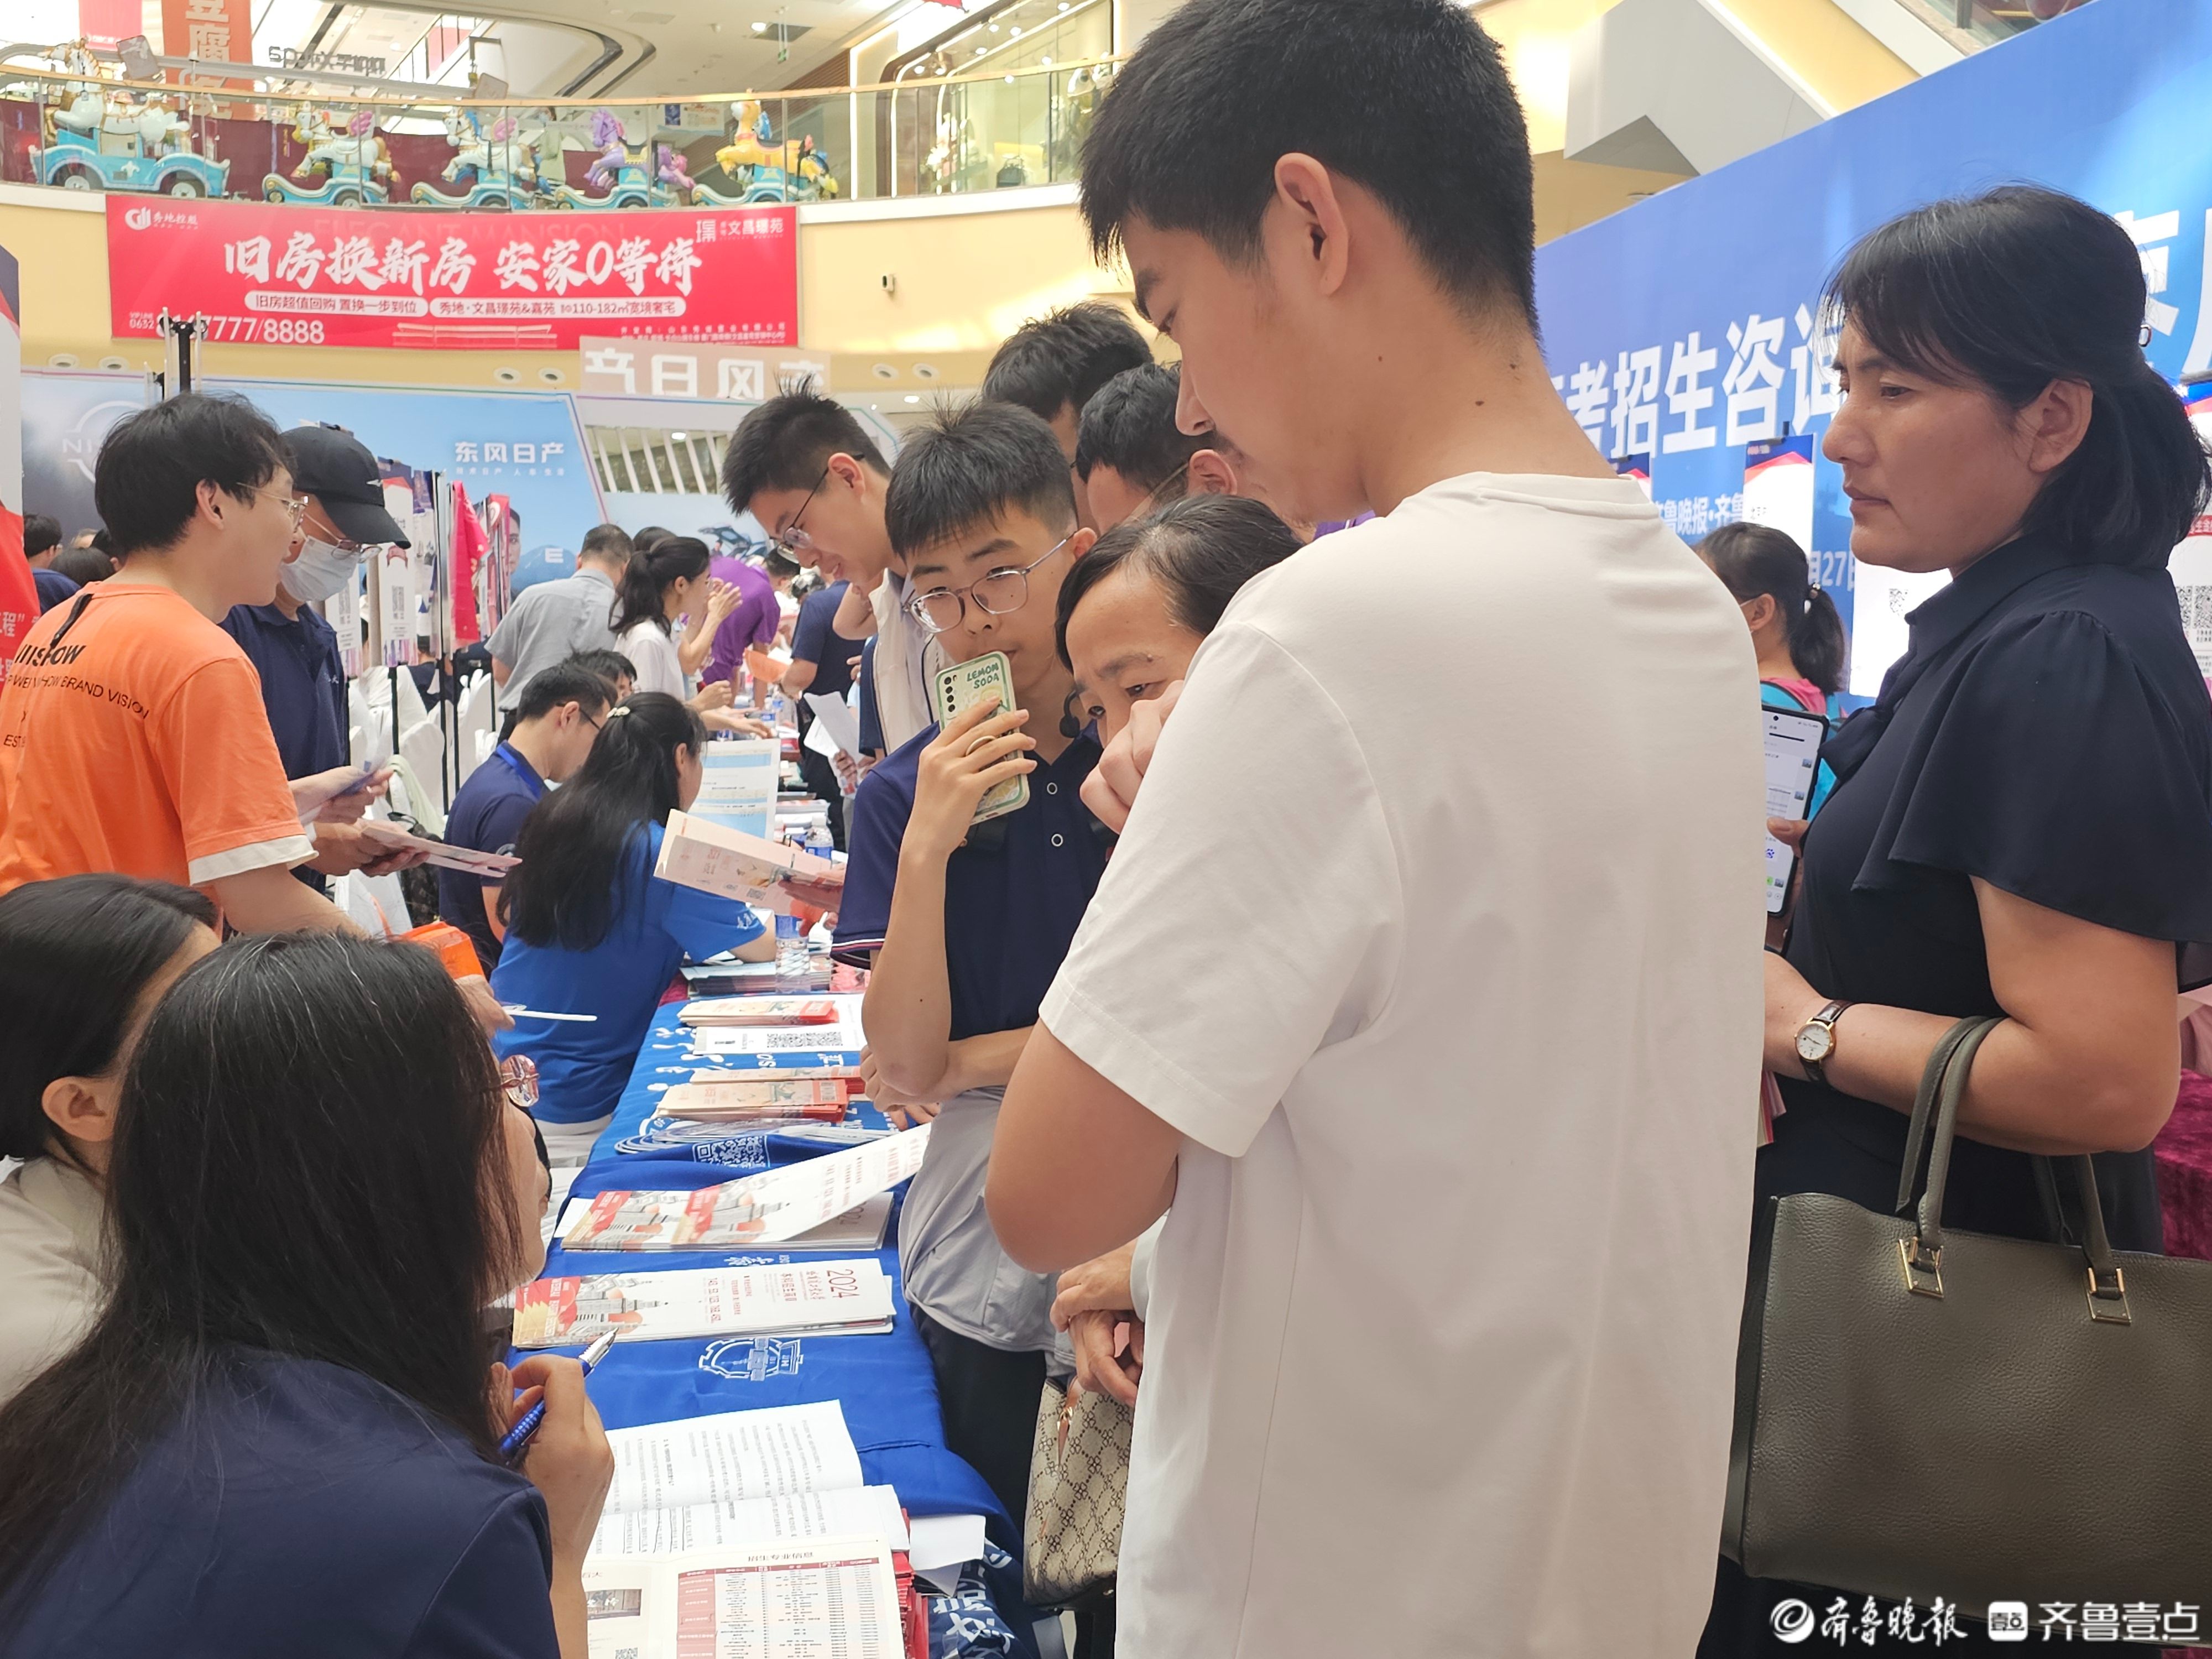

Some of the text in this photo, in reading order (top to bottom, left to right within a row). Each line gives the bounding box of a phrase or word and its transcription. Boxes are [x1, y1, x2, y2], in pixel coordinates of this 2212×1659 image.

[223, 230, 477, 296] 旧房换新房
[255, 294, 417, 314] 旧房超值回购 置换一步到位
[129, 319, 154, 329] 0632
[1551, 302, 1848, 458] 考招生咨询
[455, 442, 565, 463] 东风日产
[967, 662, 999, 681] LEMON
[974, 672, 999, 689] SODA
[60, 676, 103, 698] BRAND
[827, 1269, 860, 1298] 2024
